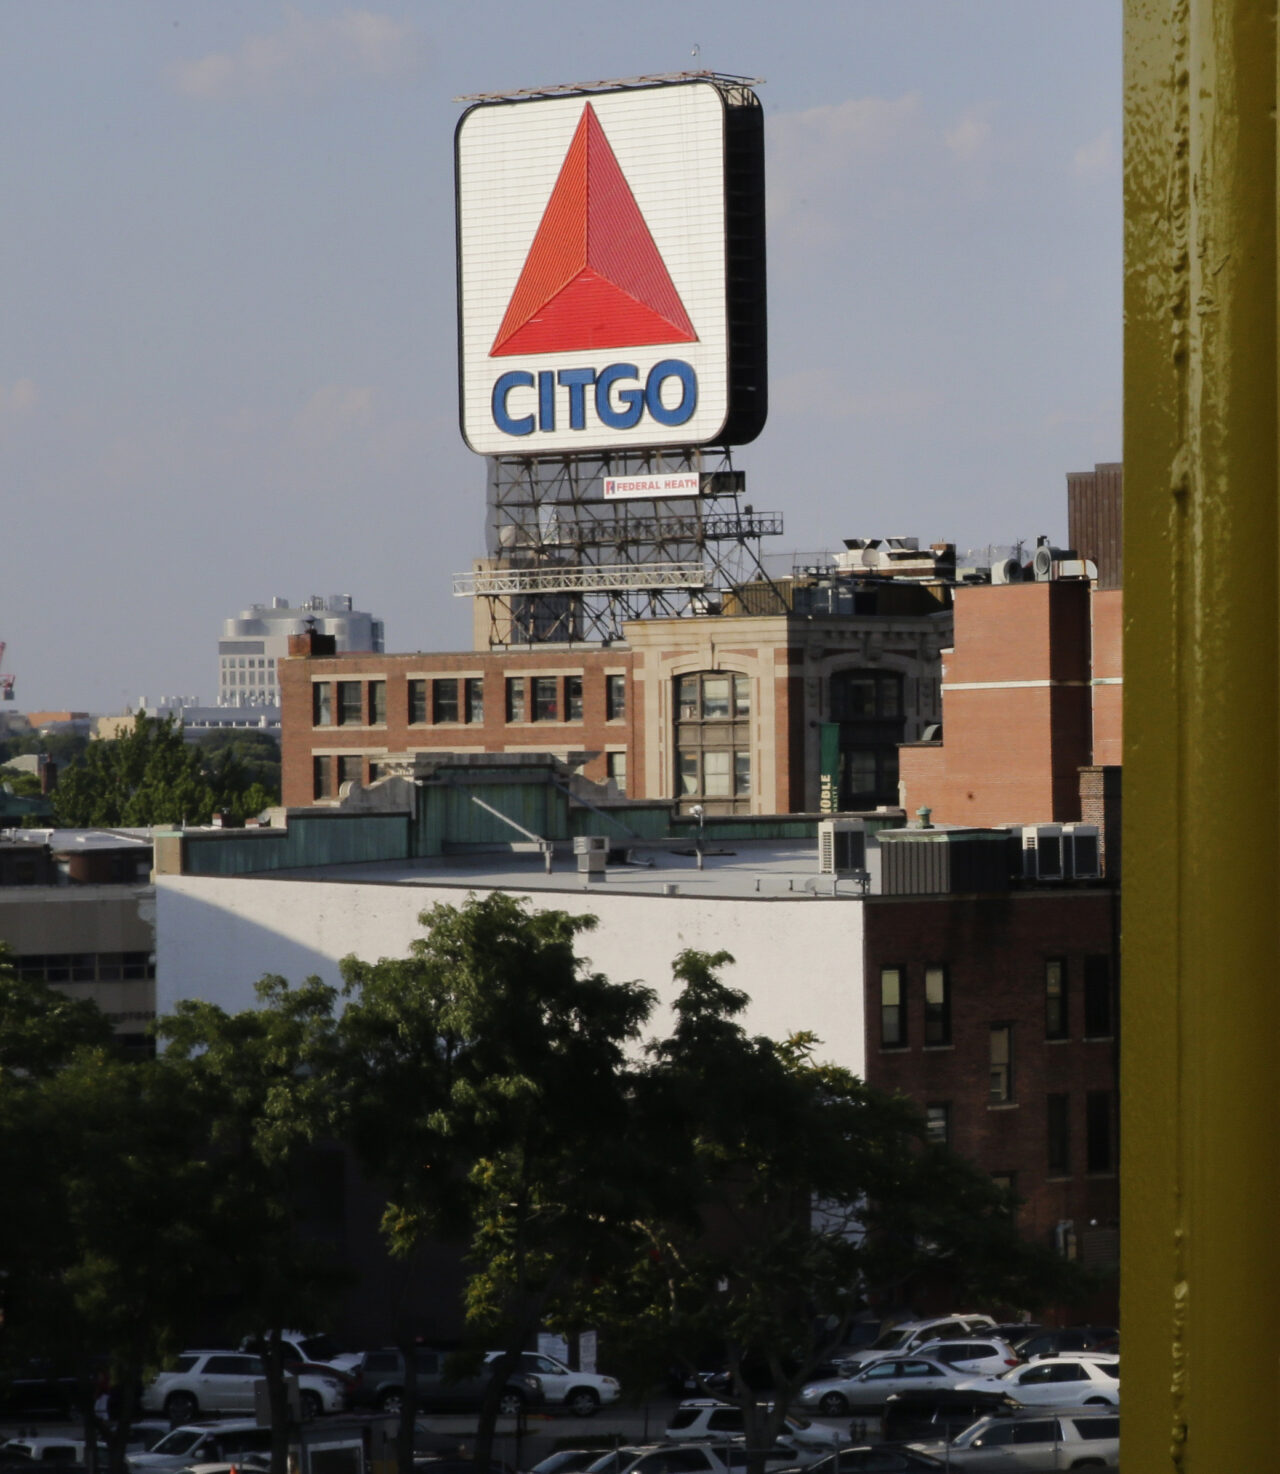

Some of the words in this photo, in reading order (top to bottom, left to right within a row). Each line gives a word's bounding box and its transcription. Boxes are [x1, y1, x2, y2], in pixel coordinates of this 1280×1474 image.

[491, 358, 698, 437] CITGO
[616, 481, 661, 492] FEDERAL
[664, 479, 698, 489] HEATH
